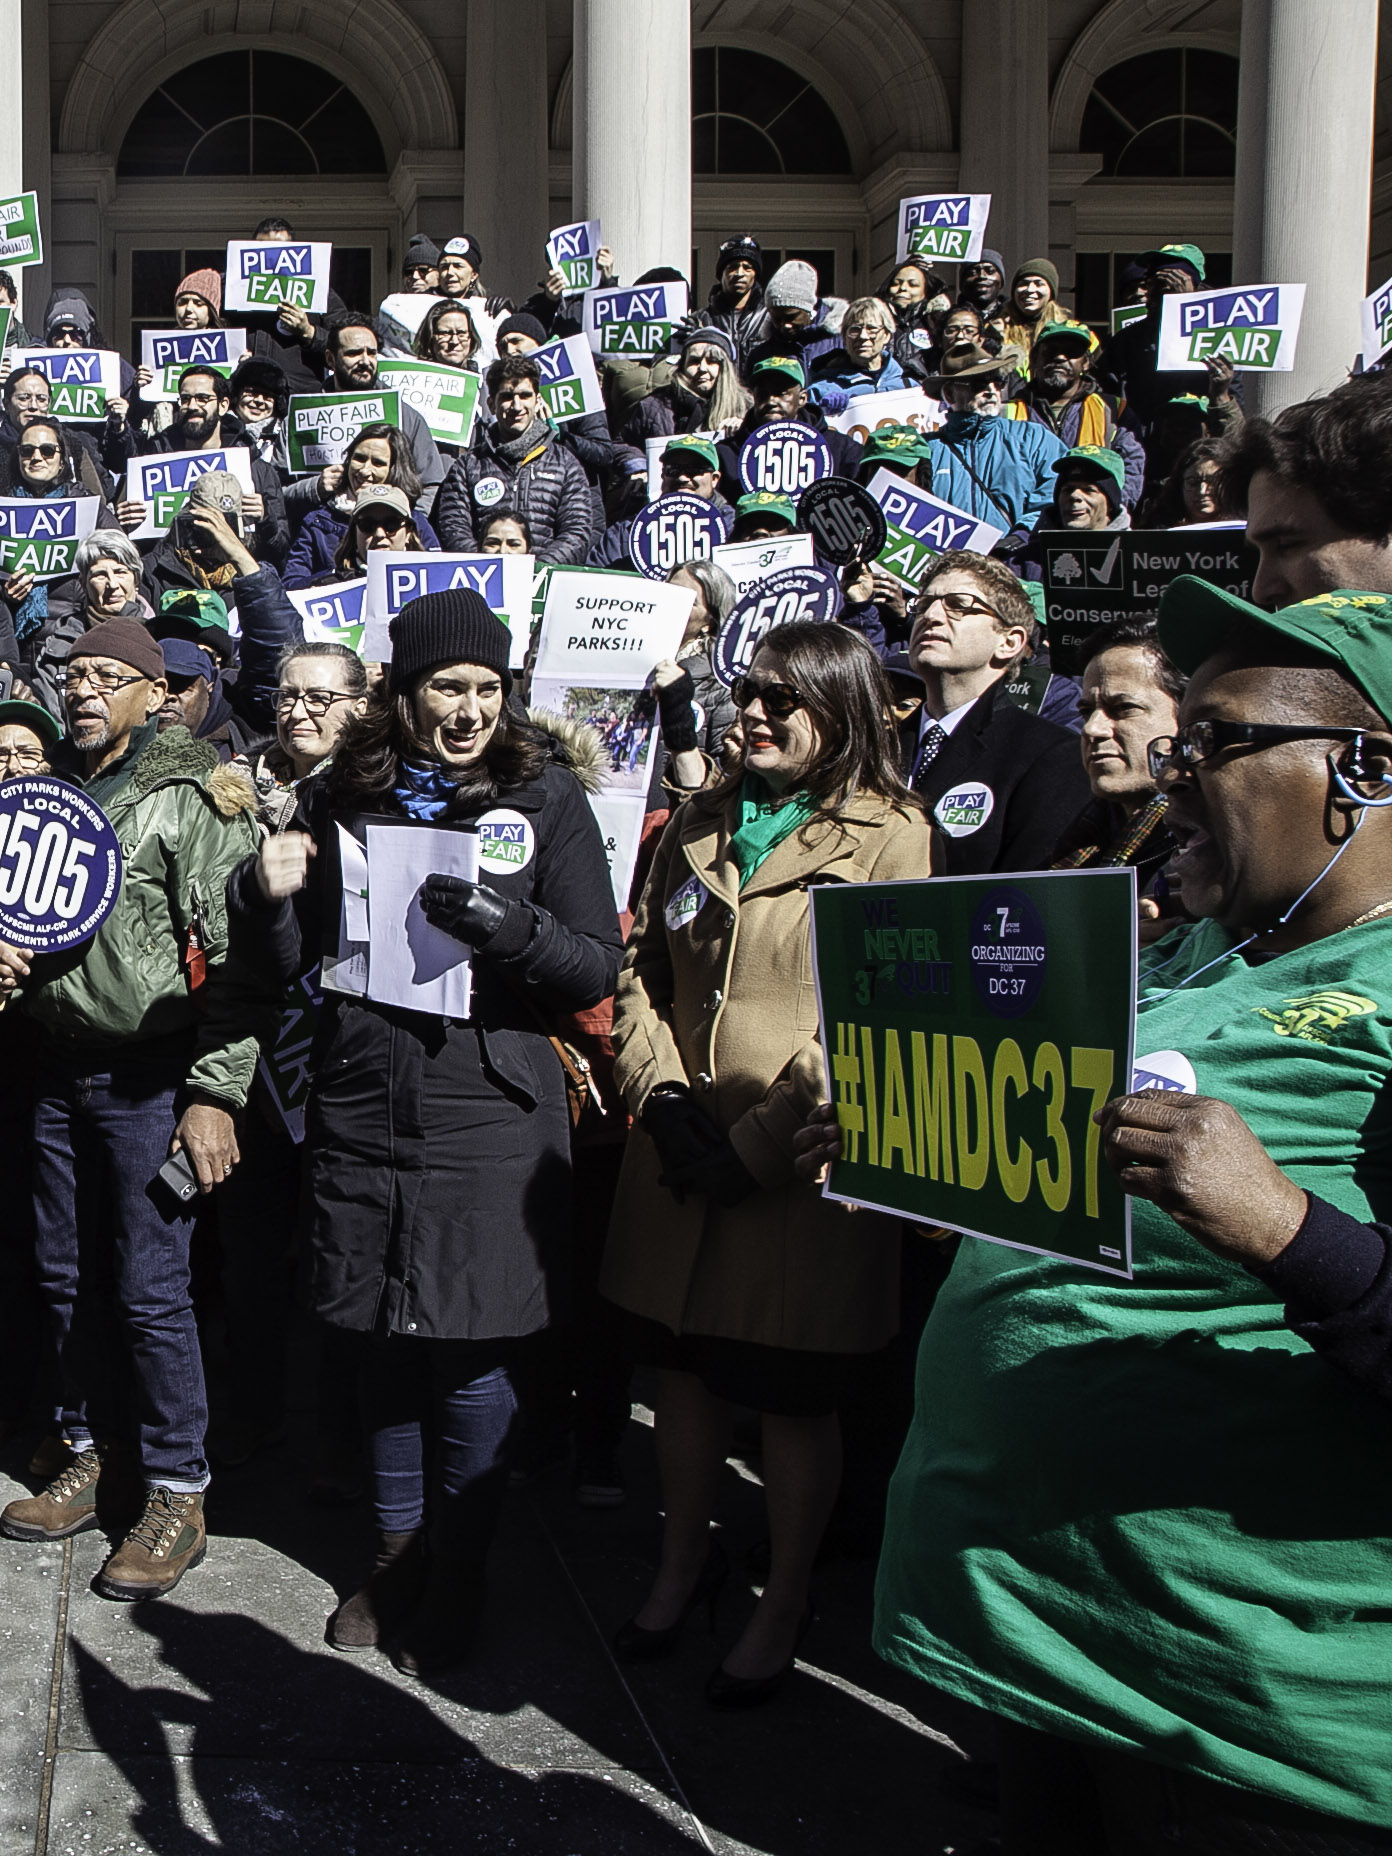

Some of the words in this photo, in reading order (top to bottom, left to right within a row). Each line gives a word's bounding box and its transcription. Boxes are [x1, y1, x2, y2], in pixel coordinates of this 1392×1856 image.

[907, 200, 966, 230] PLAY
[556, 229, 583, 261] AY
[909, 228, 964, 257] FAIR
[244, 248, 308, 275] PLAY
[251, 276, 309, 305] FAIR
[595, 289, 661, 322] PLAY
[1185, 291, 1275, 333] PLAY
[157, 335, 222, 366] PLAY
[604, 324, 667, 353] FAIR
[1192, 331, 1272, 363] FAIR
[28, 355, 97, 386] PLAY
[382, 373, 419, 388] PLAY
[424, 375, 460, 393] FAIR
[48, 387, 106, 415] AIR
[401, 388, 435, 409] FOR
[297, 408, 335, 429] PLAY
[339, 402, 381, 422] FAIR
[320, 426, 356, 442] FOR
[769, 430, 804, 441] LOCAL
[754, 440, 817, 492] 1505
[661, 503, 698, 515] LOCAL
[812, 488, 840, 504] LOCAL
[810, 494, 873, 551] 1505
[883, 492, 971, 549] PLAY
[645, 513, 711, 570] 1505
[759, 550, 776, 567] 37
[1132, 552, 1180, 570] New
[1185, 552, 1240, 570] York
[765, 580, 809, 596] LOCAL
[574, 596, 656, 614] SUPPORT
[591, 617, 628, 631] NYC
[731, 592, 820, 666] 1505
[566, 636, 644, 652] PARKS!!!
[1, 783, 23, 799] CITY
[25, 782, 60, 797] PARKS
[61, 789, 105, 832] WORKERS
[23, 798, 80, 830] LOCAL
[944, 794, 984, 809] PLAY
[945, 809, 980, 824] FAIR
[479, 826, 523, 842] PLAY
[604, 837, 617, 852] &
[484, 841, 523, 863] FAIR
[57, 927, 82, 944] PARK
[80, 899, 110, 933] SERVICE
[104, 849, 117, 899] WORKERS
[35, 919, 68, 933] ALF-CIO
[861, 897, 899, 929] WE
[863, 929, 942, 962] NEVER
[971, 945, 1045, 962] ORGANIZING
[895, 961, 953, 997] QUIT
[999, 963, 1013, 973] FOR
[989, 977, 1008, 995] DC
[1010, 979, 1026, 996] 37
[1274, 1007, 1321, 1036] 37
[832, 1021, 1115, 1219] #IAMDC37
